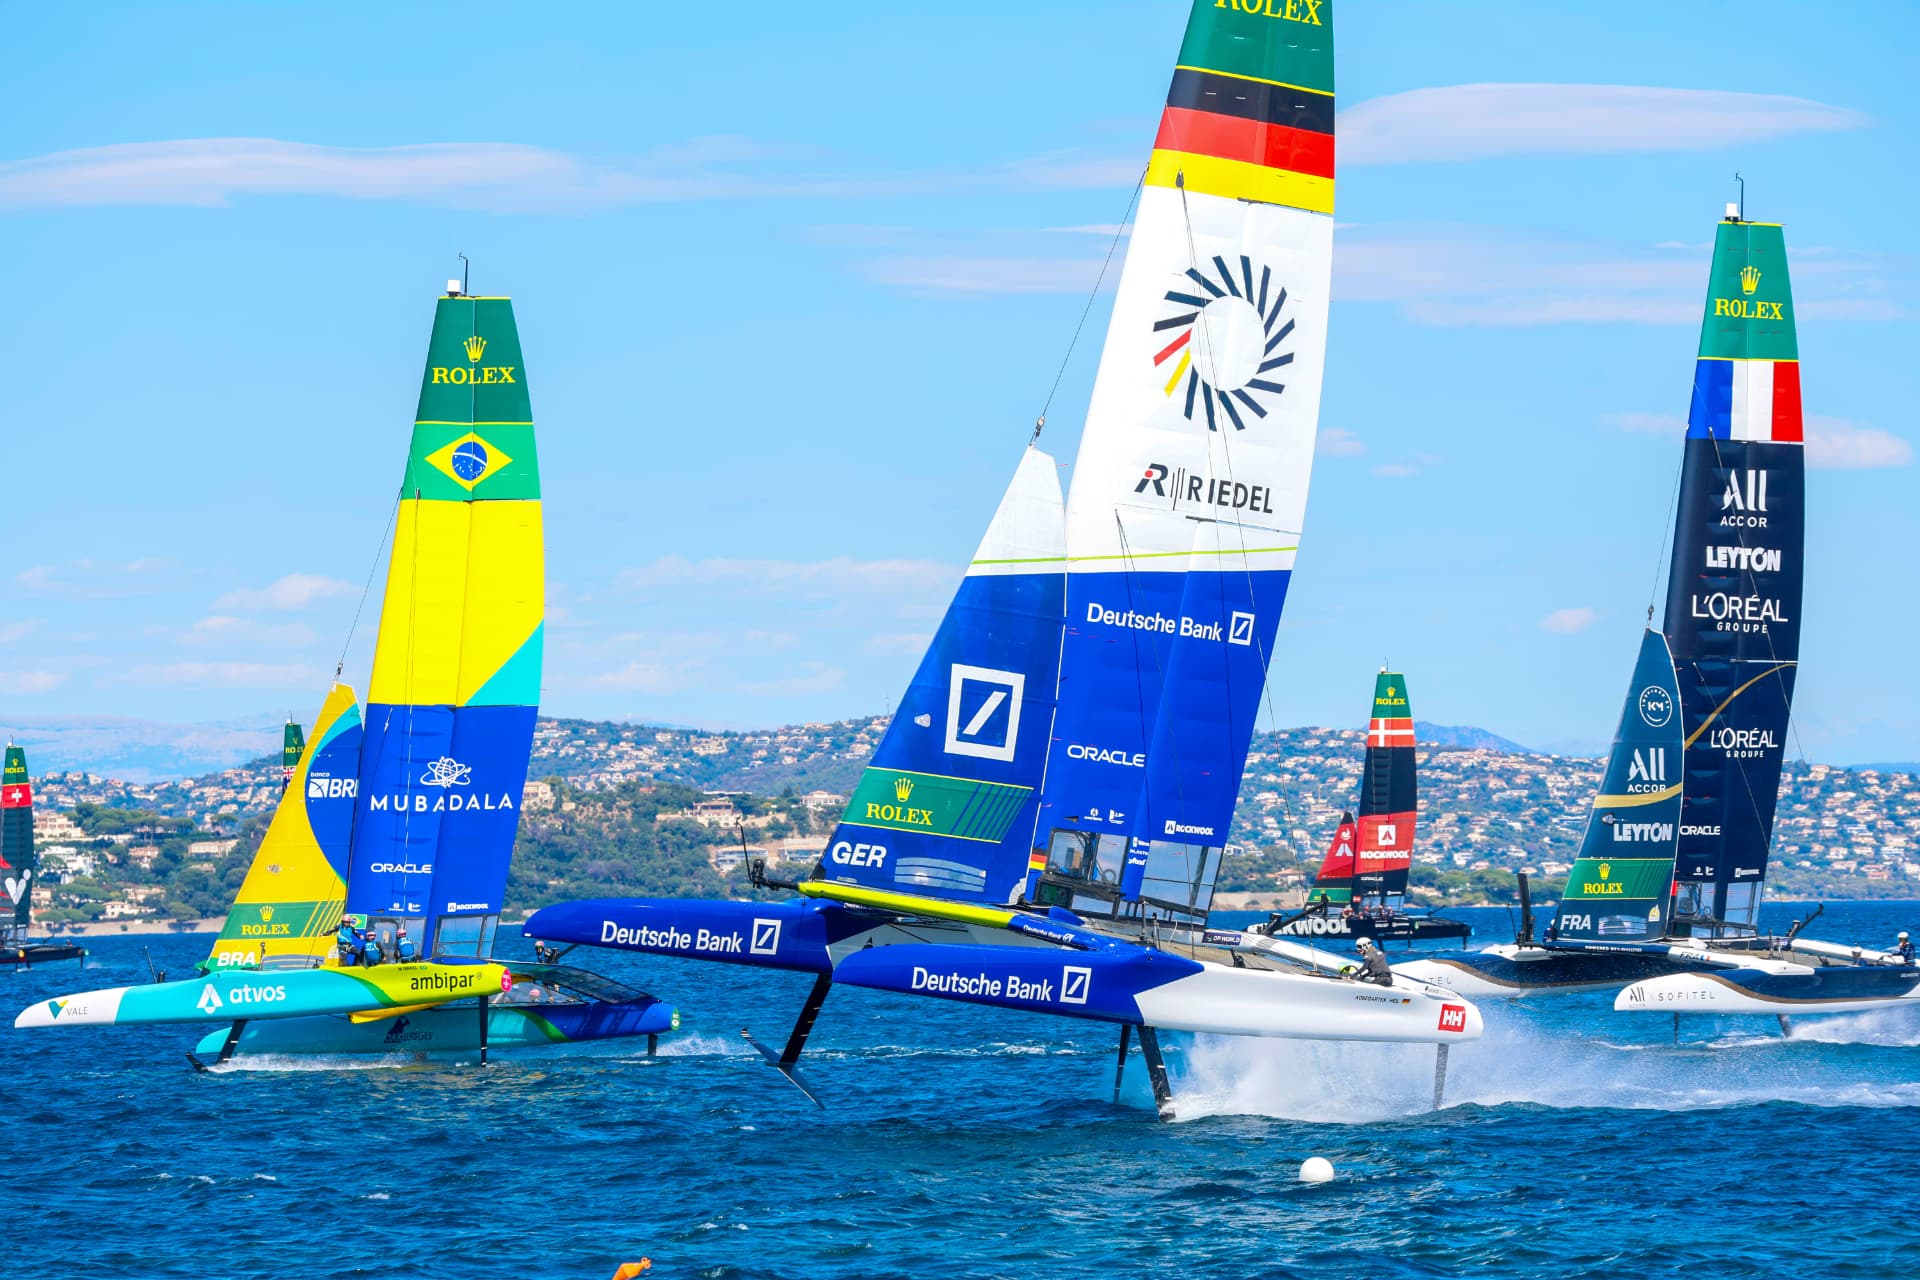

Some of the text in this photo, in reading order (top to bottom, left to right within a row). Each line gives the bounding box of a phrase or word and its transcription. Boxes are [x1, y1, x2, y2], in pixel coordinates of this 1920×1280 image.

[1714, 298, 1784, 320] ROLEX
[432, 367, 516, 384] ROLEX
[1187, 475, 1273, 514] RIEDEL
[1720, 516, 1767, 528] ACCOR
[1706, 545, 1781, 572] LEYTON
[1692, 592, 1788, 623] L'ORÉAL
[1086, 603, 1223, 641] Deutsche Bank
[1717, 621, 1768, 634] GROUPE
[1375, 697, 1406, 705] ROLEX
[1711, 727, 1778, 749] L'ORÉAL
[1067, 745, 1146, 767] ORACLE
[1726, 750, 1764, 758] GROUPE
[1627, 784, 1666, 793] ACCOR
[370, 793, 513, 813] MUBADALA
[866, 803, 933, 826] ROLEX
[1175, 824, 1214, 836] ROCKWOOL
[1613, 822, 1673, 843] LEYTON
[1679, 825, 1720, 836] ORACLE
[832, 841, 887, 868] GER
[1360, 850, 1409, 859] ROCKWOOL
[370, 863, 432, 874] ORACLE
[1583, 883, 1623, 894] ROLEX
[241, 924, 291, 935] ROLEX
[1560, 914, 1592, 930] FRA
[601, 920, 743, 953] Deutsche Bank
[217, 952, 256, 967] BRA
[411, 973, 474, 992] ambipar
[911, 966, 1053, 1001] Deutsche Bank
[229, 984, 286, 1004] atvos
[1658, 991, 1715, 1002] SOFITEL
[66, 1006, 88, 1016] VALE
[1442, 1010, 1463, 1027] HH
